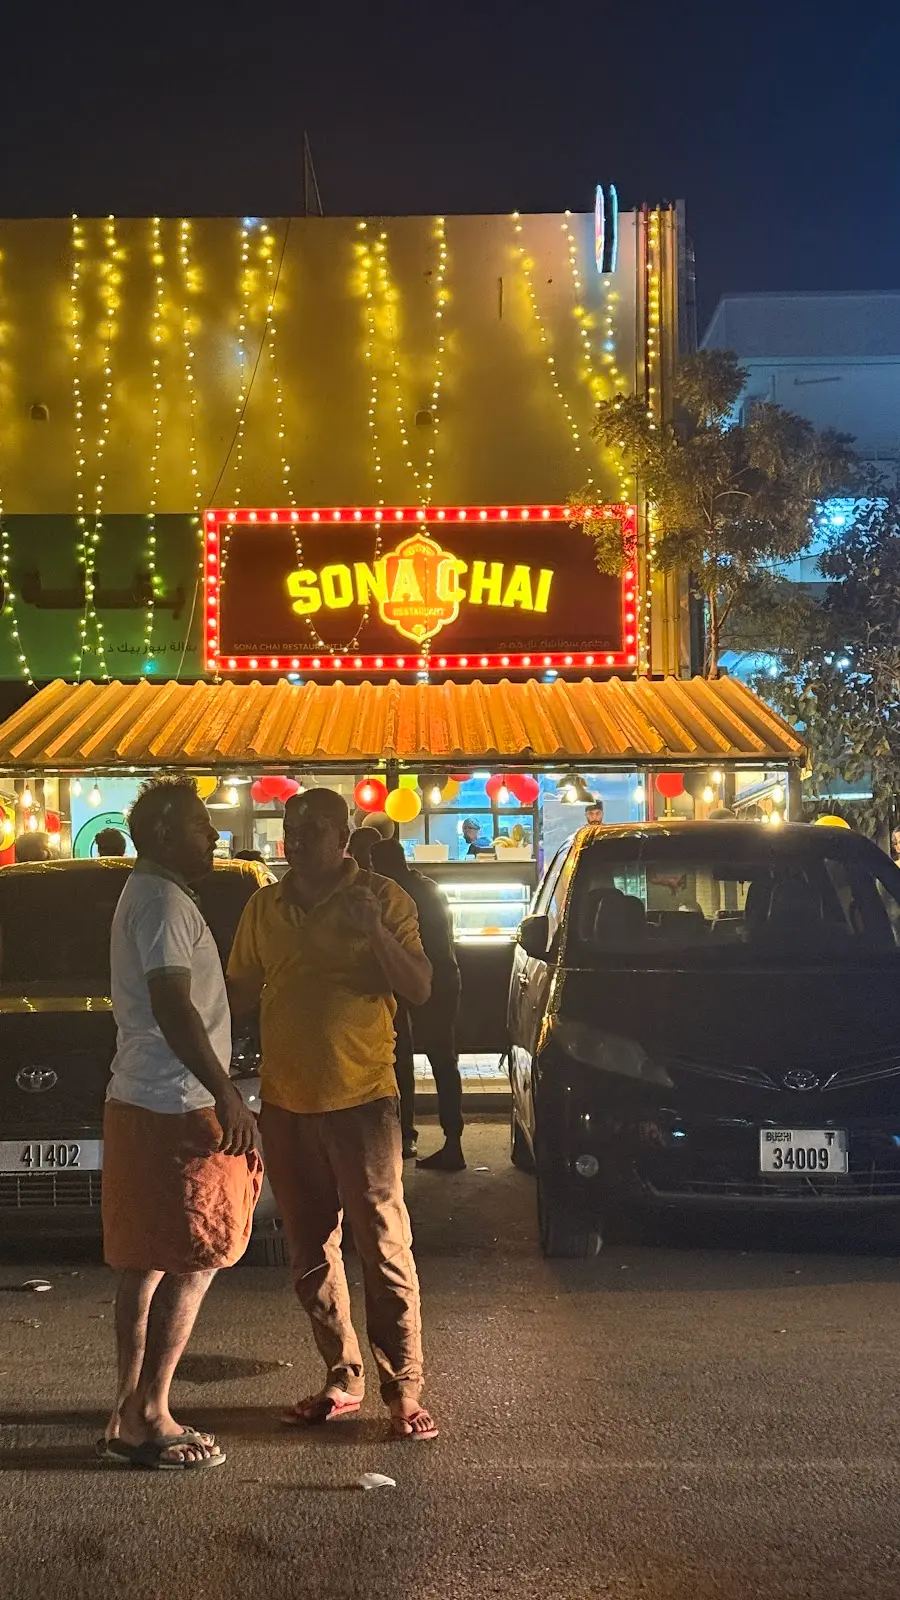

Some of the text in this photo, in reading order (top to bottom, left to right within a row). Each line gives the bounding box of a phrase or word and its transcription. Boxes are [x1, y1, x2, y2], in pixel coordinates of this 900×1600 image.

[286, 558, 554, 614] SONA CHAI
[233, 643, 258, 651] SONA
[260, 643, 280, 651] CHAI
[824, 1132, 836, 1146] T
[21, 1144, 81, 1168] 41402
[773, 1147, 829, 1170] 34009
